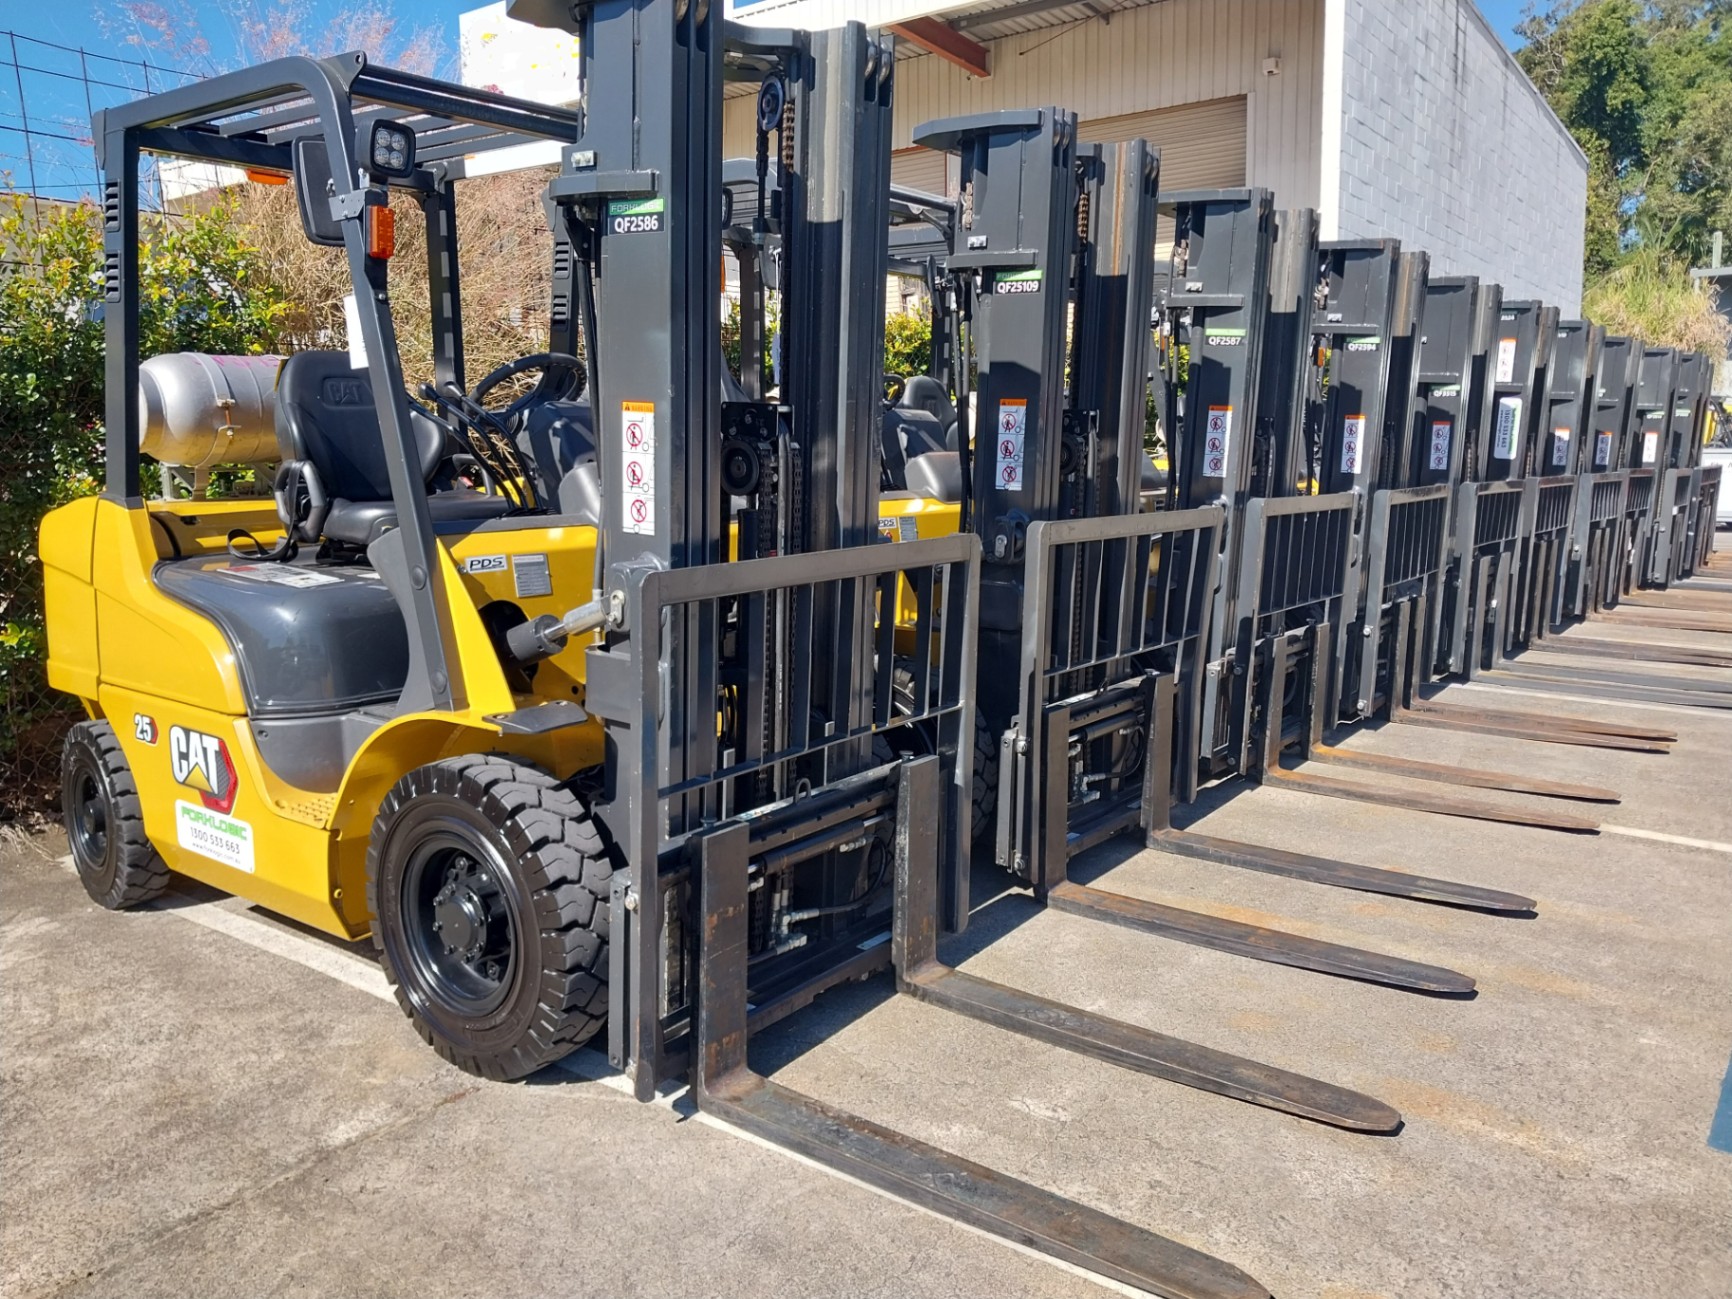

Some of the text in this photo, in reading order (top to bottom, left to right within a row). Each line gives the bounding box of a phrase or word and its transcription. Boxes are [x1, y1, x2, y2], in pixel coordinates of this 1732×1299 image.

[614, 215, 658, 234] QF2586
[997, 280, 1039, 294] QF25109
[1208, 336, 1242, 346] QF2587
[469, 556, 504, 569] PDS
[134, 713, 152, 744] 25
[170, 726, 220, 795] CAT
[181, 806, 248, 841] FORKLOGIC
[190, 826, 241, 855] 1300 533 663
